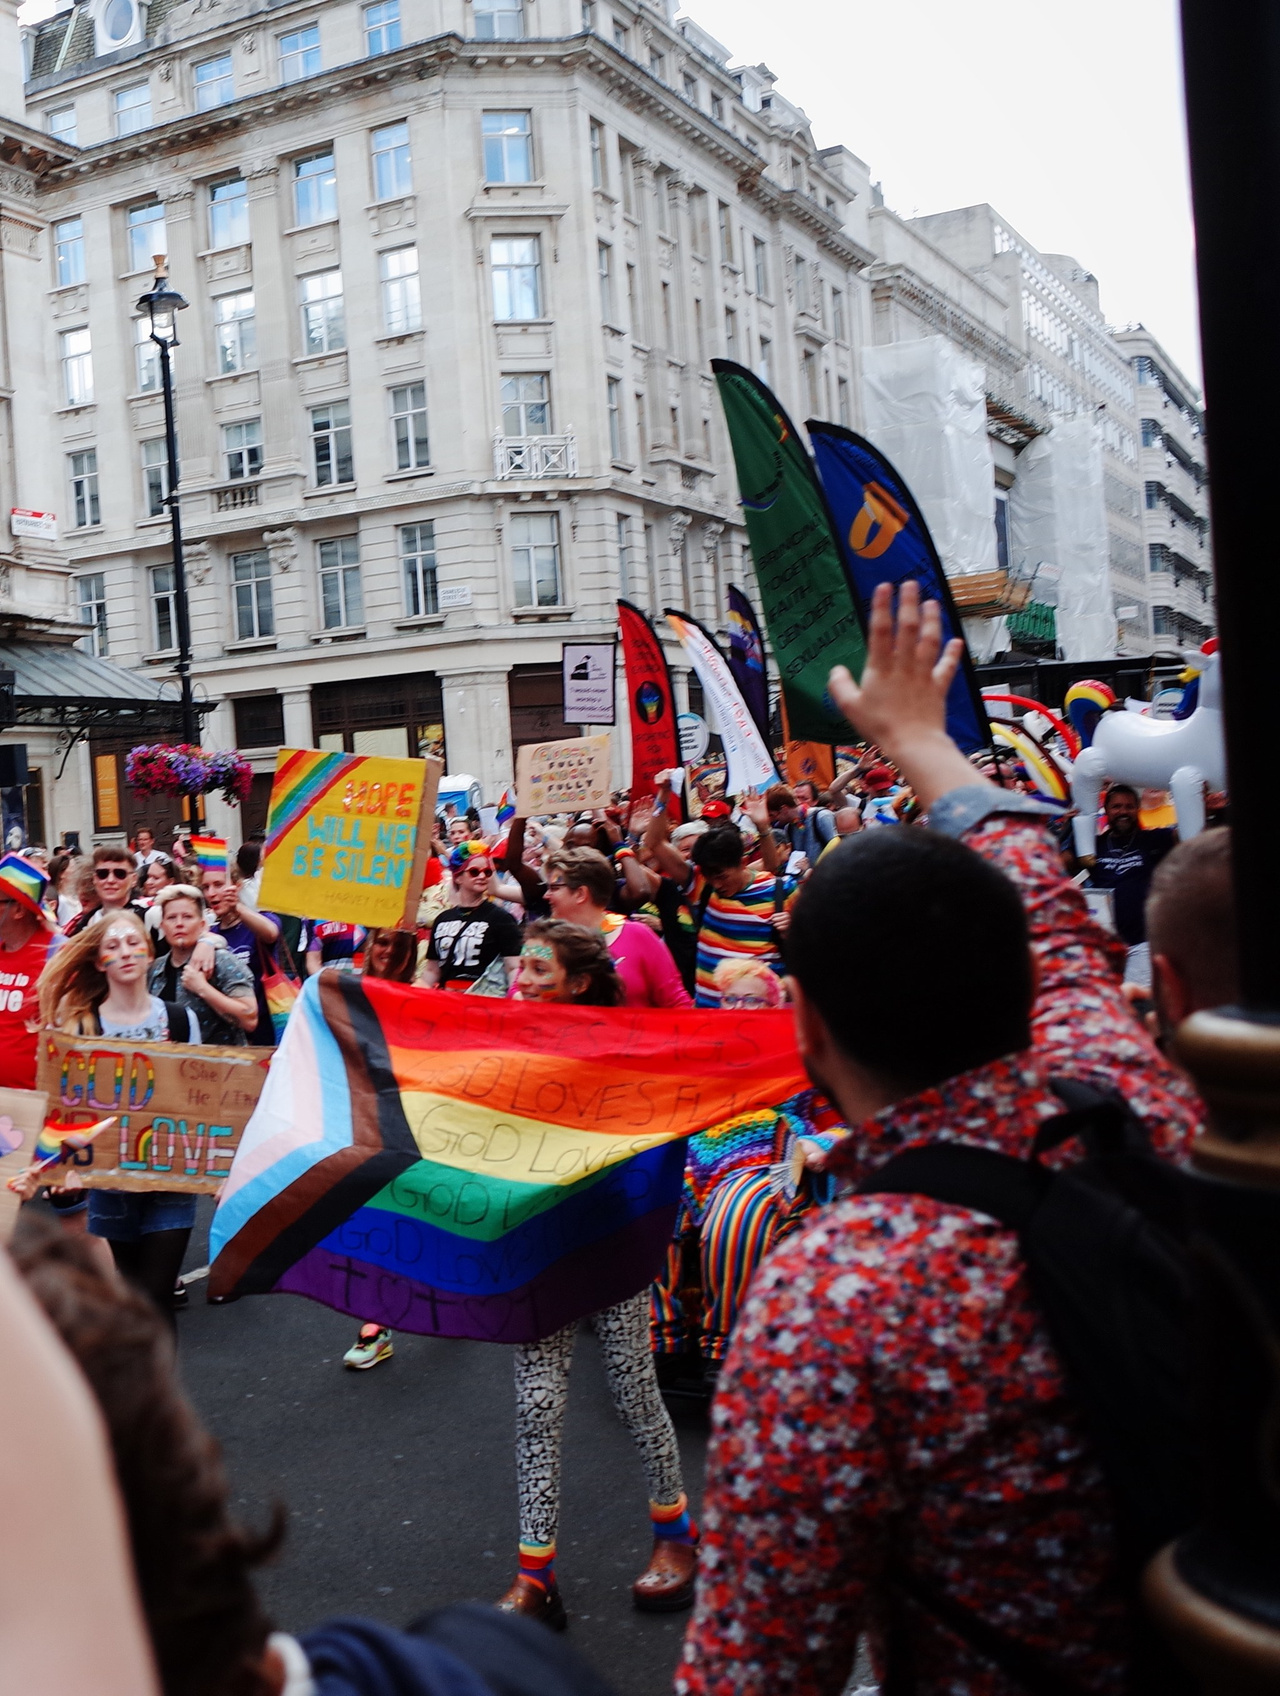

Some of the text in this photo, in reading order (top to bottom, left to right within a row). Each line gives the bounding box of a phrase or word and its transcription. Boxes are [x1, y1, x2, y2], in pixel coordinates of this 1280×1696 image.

[777, 594, 837, 650] GENDER
[783, 610, 857, 681] SEXUALITY
[548, 779, 594, 792] FULLY
[549, 757, 595, 769] FULLY
[342, 780, 416, 818] HOPE
[307, 815, 366, 850] WILL
[292, 844, 326, 879] BE
[397, 1000, 492, 1045] GOD
[60, 1049, 155, 1112] GOD
[410, 1053, 505, 1100] GOD
[509, 1058, 658, 1128] LOVES
[119, 1115, 236, 1178] LOVE
[417, 1103, 520, 1164] GOD
[389, 1166, 490, 1226] GOD
[338, 1215, 421, 1265] GOD
